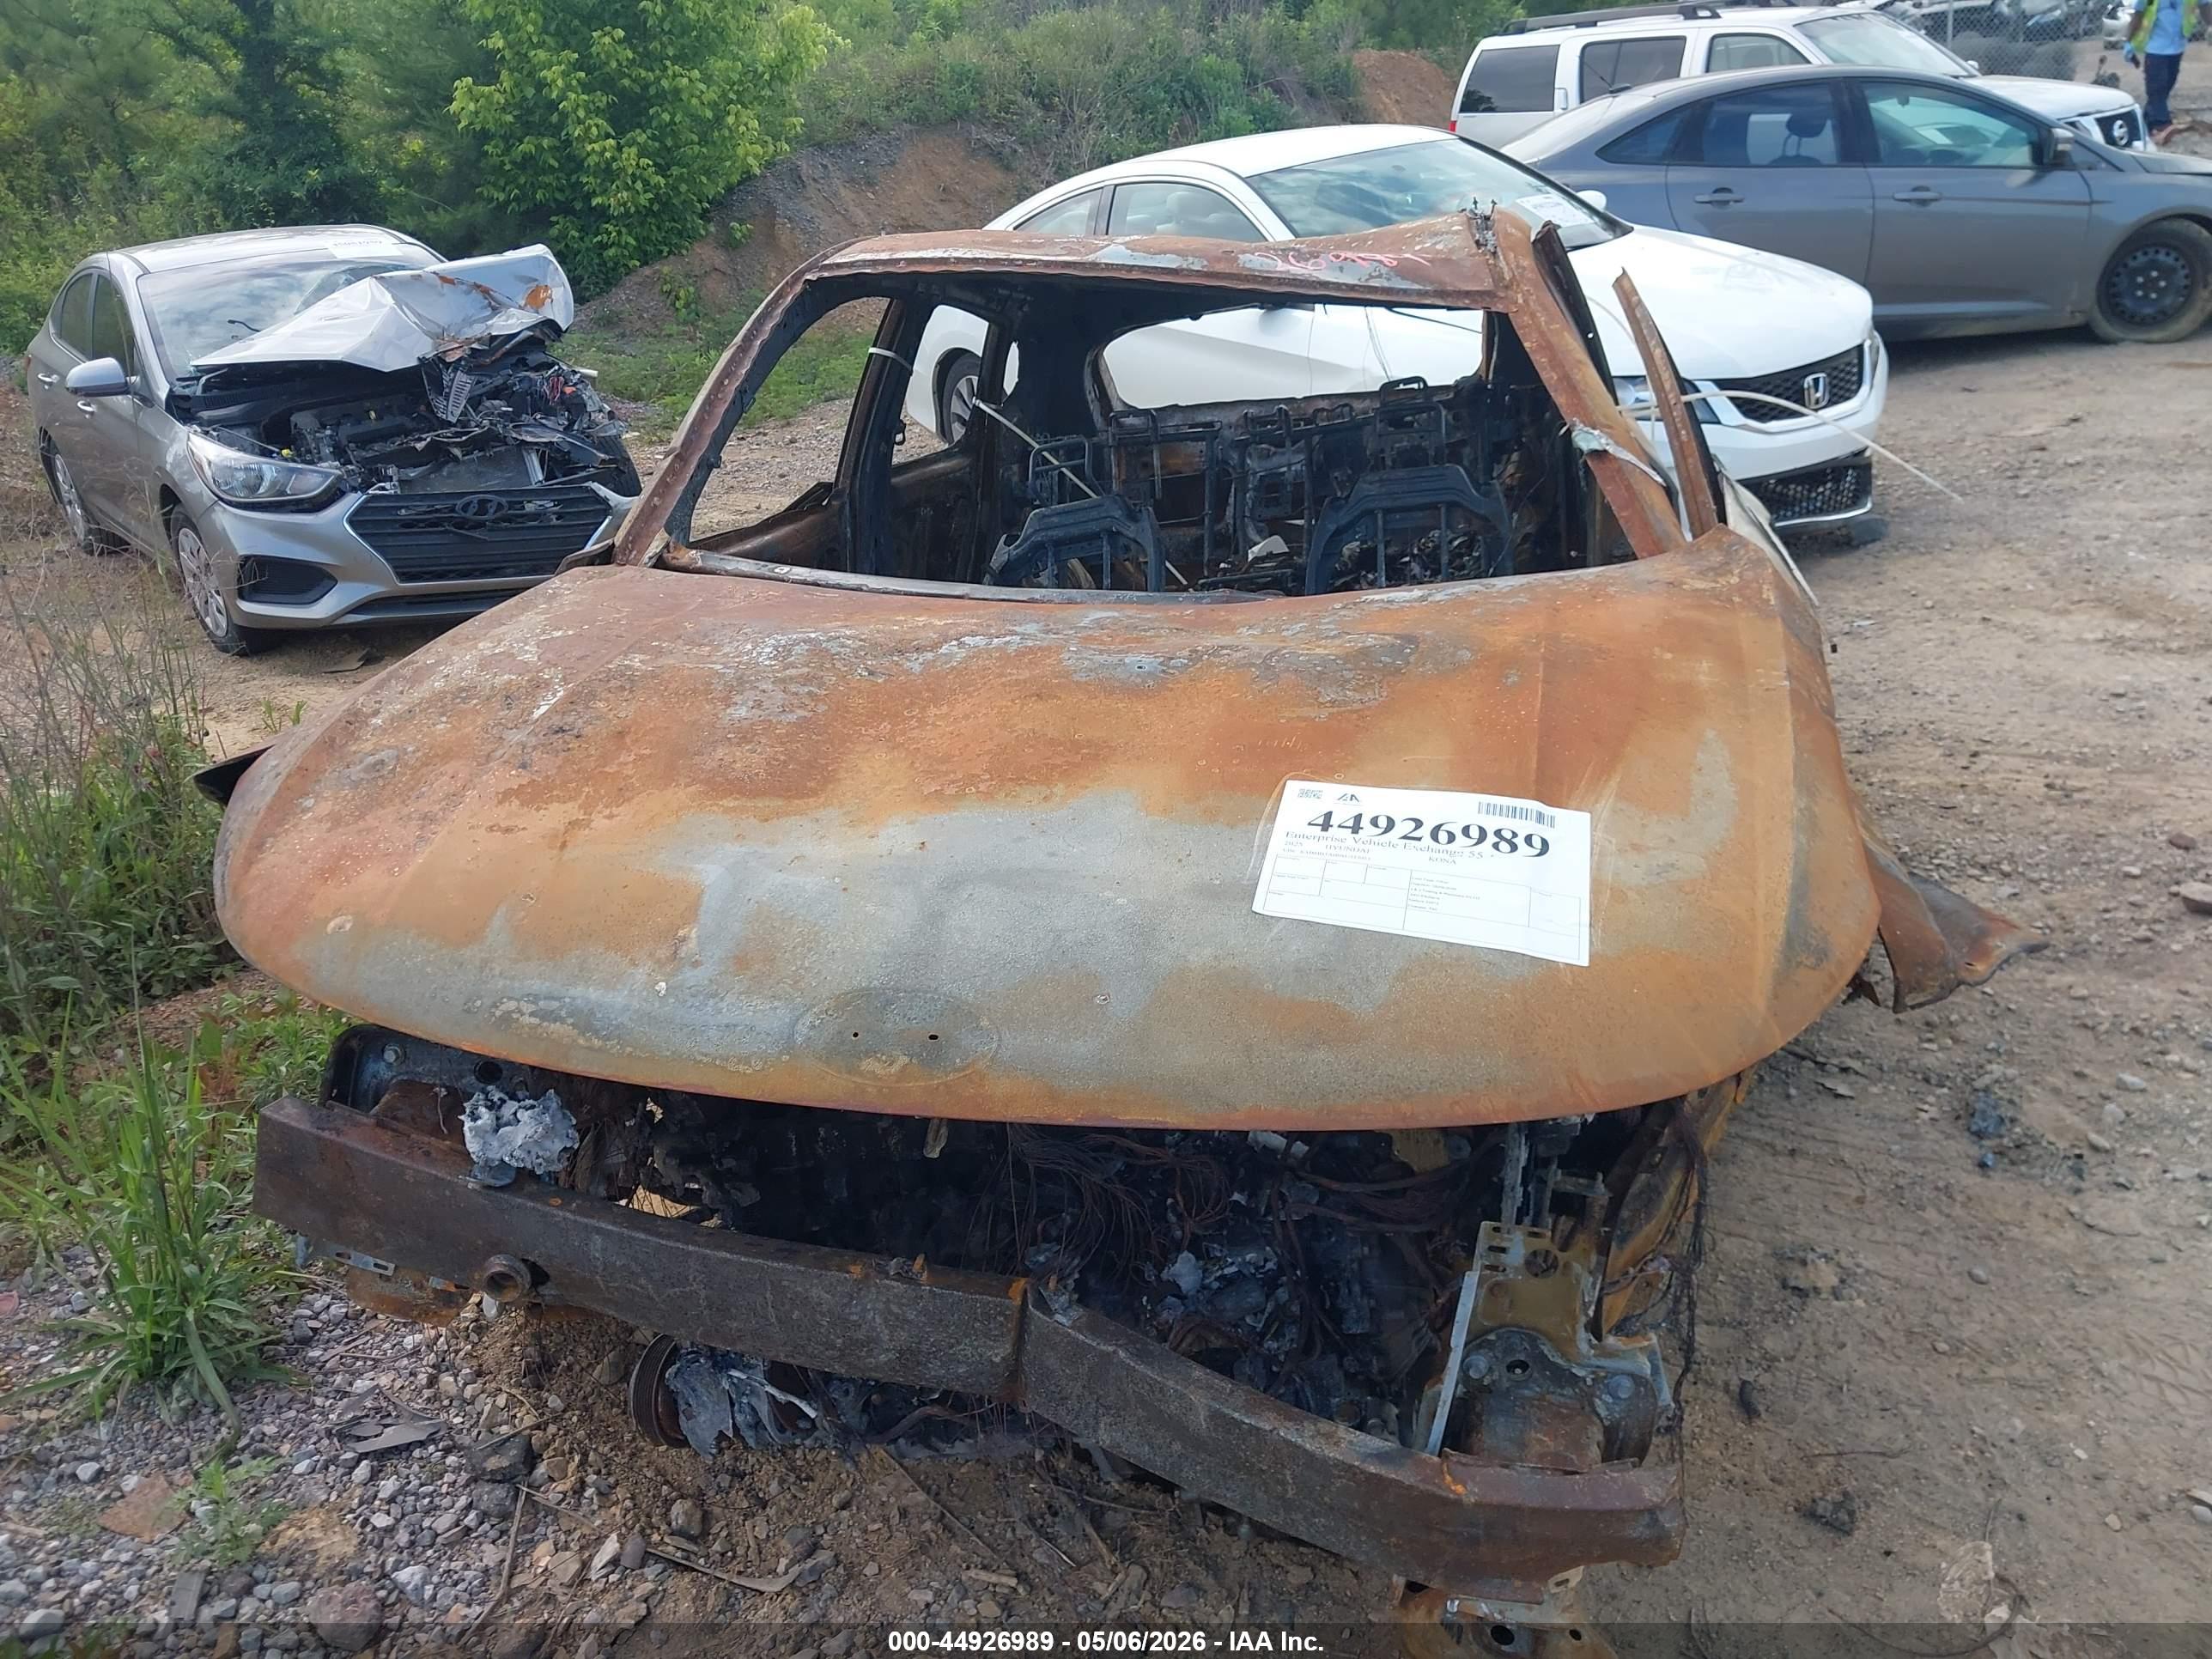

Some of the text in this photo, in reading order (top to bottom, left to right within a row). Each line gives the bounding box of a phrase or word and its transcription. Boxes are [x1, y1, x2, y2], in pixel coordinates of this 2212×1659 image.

[1307, 810, 1551, 858] 44926989
[1285, 830, 1348, 844] Enterprise
[1352, 836, 1401, 849] Vehicle
[1403, 842, 1464, 858] Exchange
[1325, 843, 1371, 854] HYUNDAI
[1428, 855, 1457, 866] KONA
